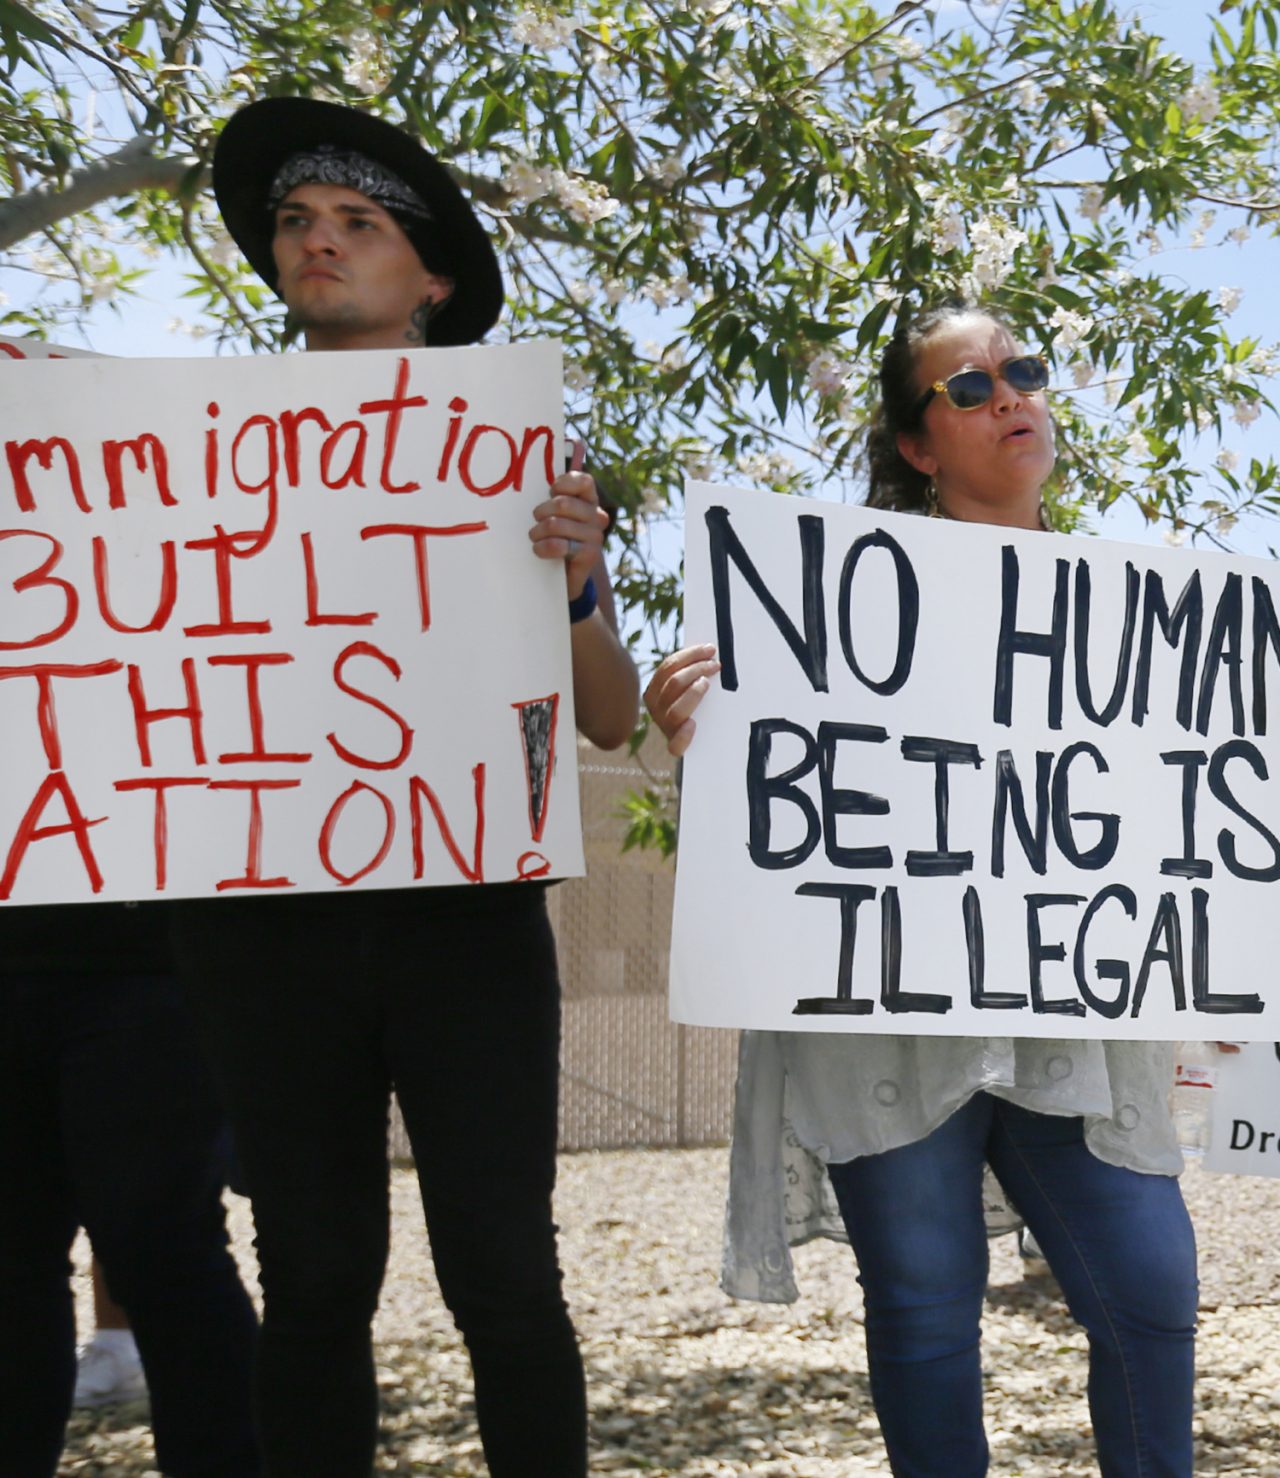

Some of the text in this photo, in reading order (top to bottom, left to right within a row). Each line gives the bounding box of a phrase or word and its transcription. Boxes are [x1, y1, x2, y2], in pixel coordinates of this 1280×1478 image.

[705, 505, 919, 696] NO
[0, 641, 414, 771] THIS
[746, 718, 1121, 878] BEING
[791, 882, 1265, 1019] ILLEGAL
